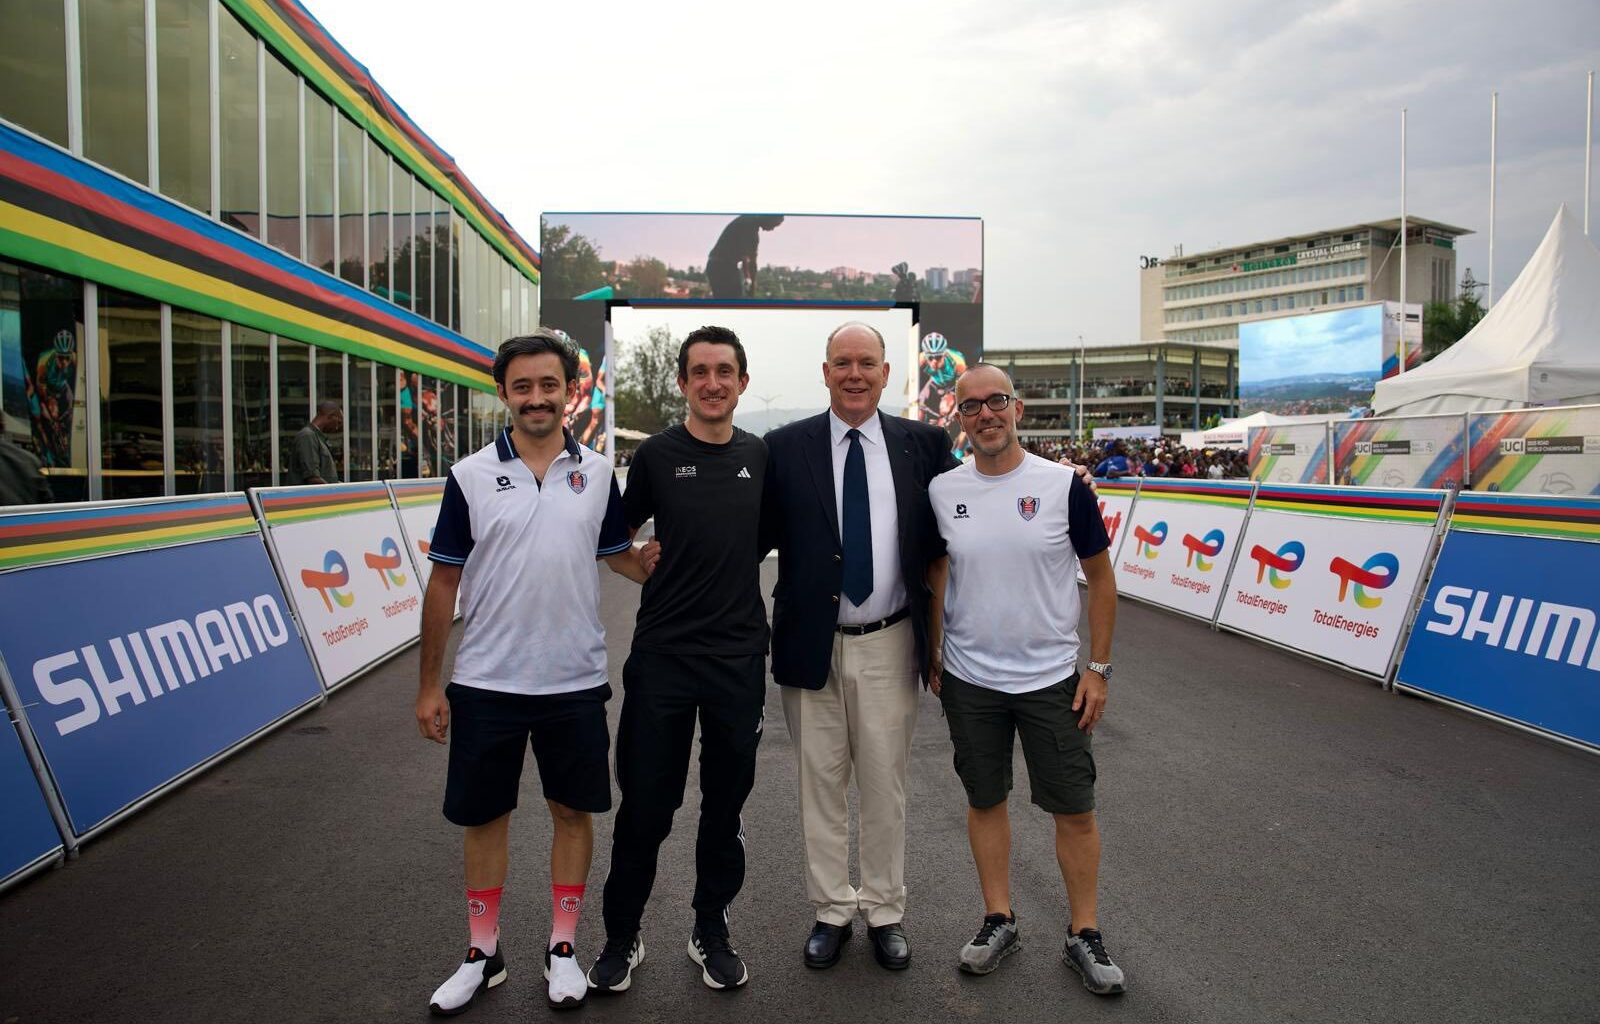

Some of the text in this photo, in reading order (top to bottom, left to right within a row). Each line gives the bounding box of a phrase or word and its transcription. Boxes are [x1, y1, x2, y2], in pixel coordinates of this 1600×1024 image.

[1297, 242, 1361, 259] CRYSTAL LOUNGE
[1357, 444, 1371, 453] UCI
[1504, 441, 1524, 452] UCI
[675, 466, 697, 474] INEOS
[1122, 561, 1156, 580] TotalEnergies
[1170, 574, 1211, 595] TotalEnergies
[382, 595, 418, 618] TotalEnergies
[1236, 591, 1288, 615] TotalEnergies
[322, 617, 369, 647] TotalEnergies
[1312, 609, 1380, 639] TotalEnergies
[33, 594, 289, 737] SHIMANO
